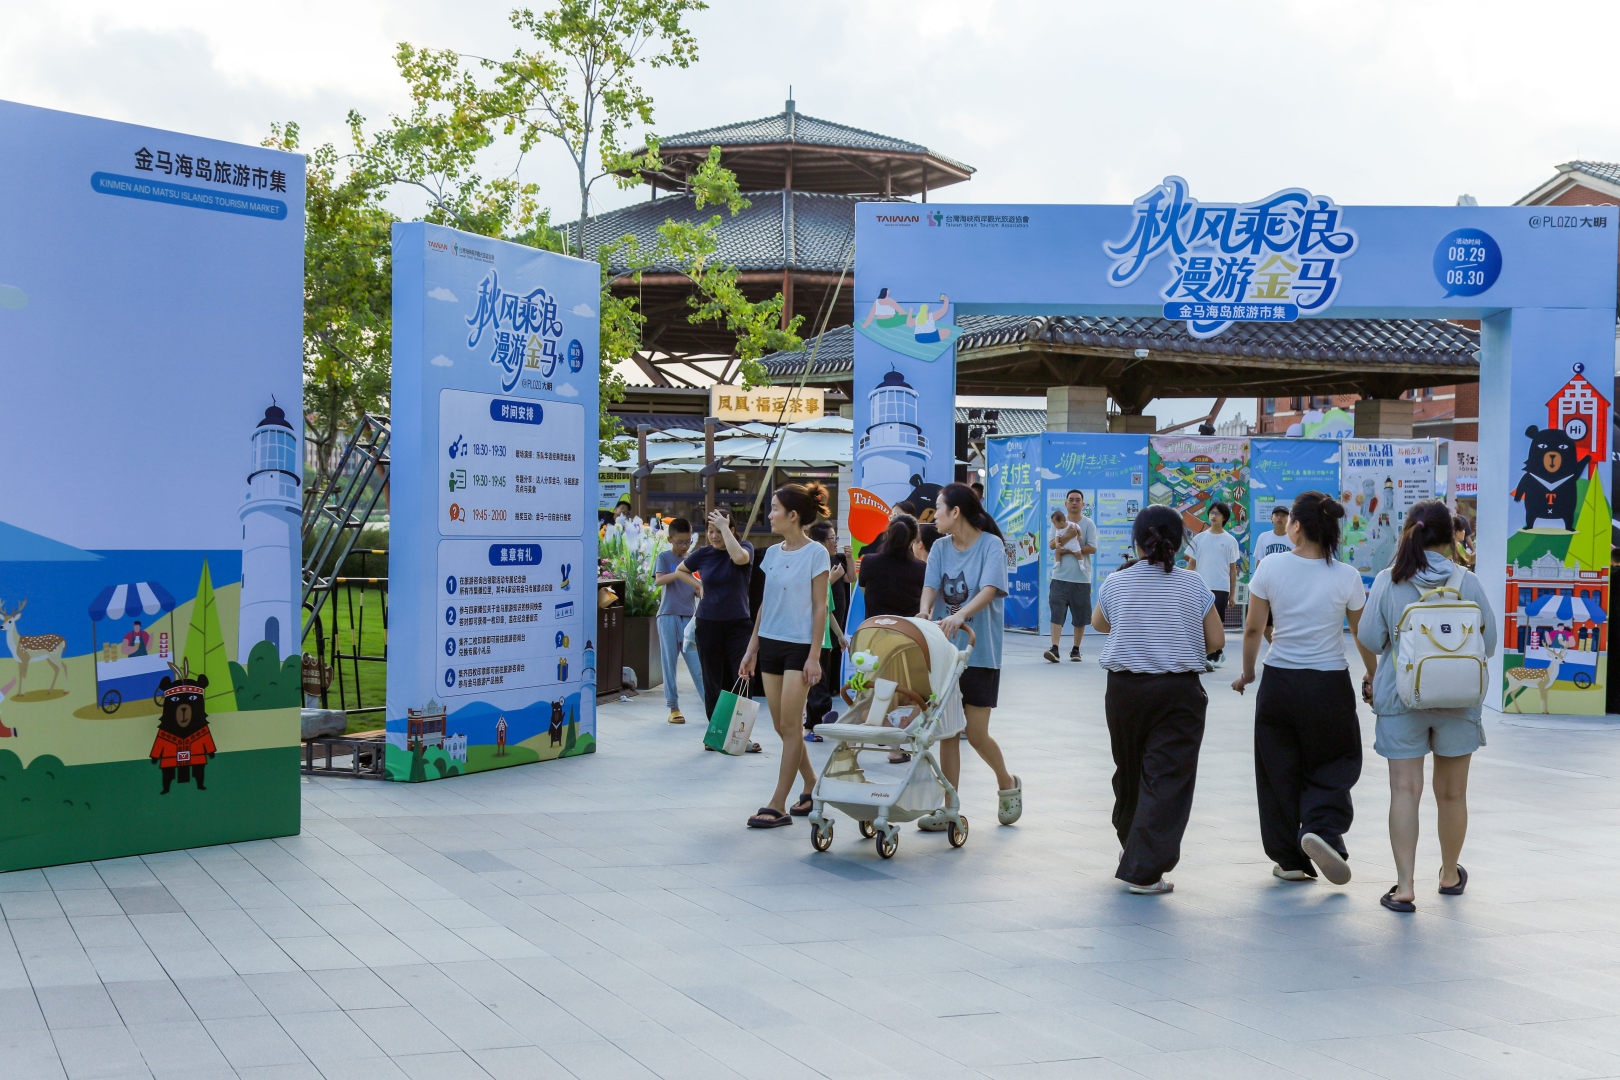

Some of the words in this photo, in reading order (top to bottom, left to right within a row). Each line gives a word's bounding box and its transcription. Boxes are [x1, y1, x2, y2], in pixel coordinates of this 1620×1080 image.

[134, 146, 287, 193] 金马海岛旅游市集
[100, 178, 132, 191] KINMEN
[133, 184, 151, 194] AND
[152, 187, 180, 199] MATSU
[181, 191, 213, 205] ISLANDS
[215, 196, 249, 209] TOURISM
[250, 201, 280, 214] MARKET
[876, 215, 920, 223] TAIWAN
[1108, 180, 1354, 281] 秋风乘浪
[1448, 247, 1486, 262] 08.29
[1446, 270, 1485, 286] 08.30
[1165, 253, 1337, 333] 漫游金马
[466, 269, 563, 348] 秋风乘浪
[1179, 304, 1286, 320] 金马海岛旅游市集
[490, 331, 559, 392] 漫游金马
[501, 404, 534, 421] 时间安排
[1569, 425, 1582, 435] Hi
[853, 492, 890, 514] Taiwan
[500, 547, 533, 562] 集章有礼
